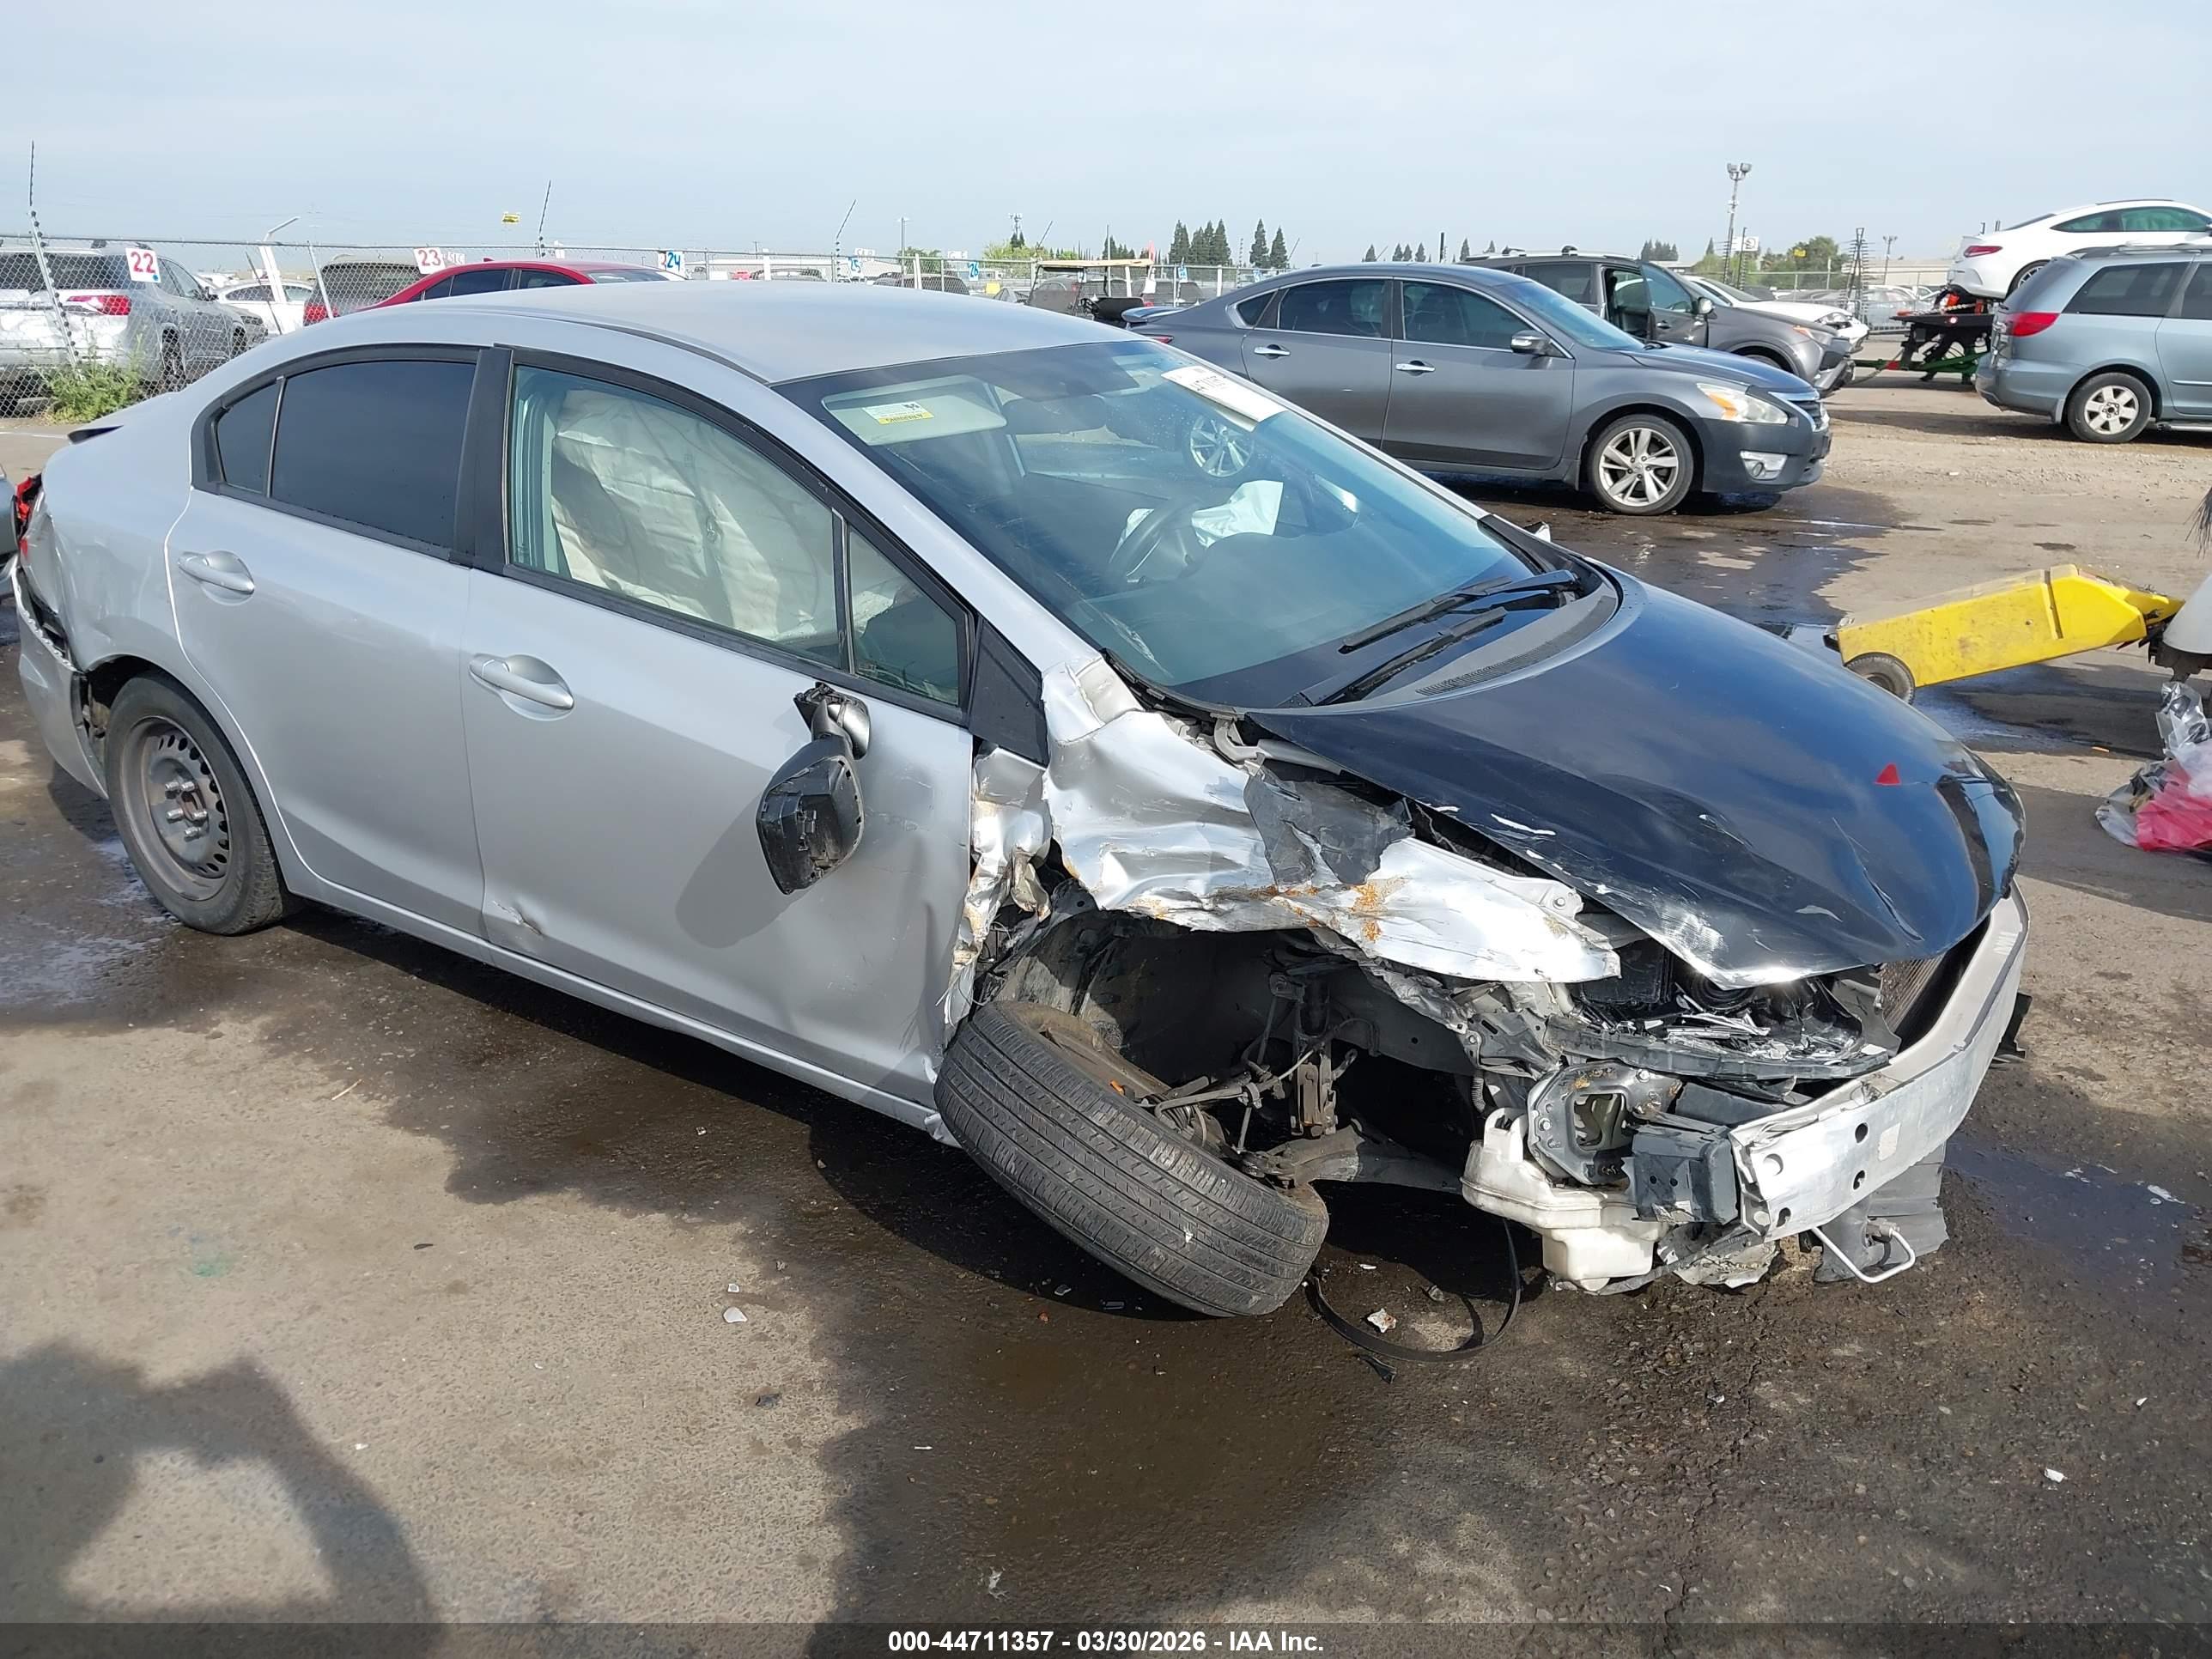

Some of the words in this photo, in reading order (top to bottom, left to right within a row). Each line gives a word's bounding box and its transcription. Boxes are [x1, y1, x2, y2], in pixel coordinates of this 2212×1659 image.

[131, 252, 155, 273] 22
[418, 249, 441, 266] 23
[667, 252, 680, 272] 24
